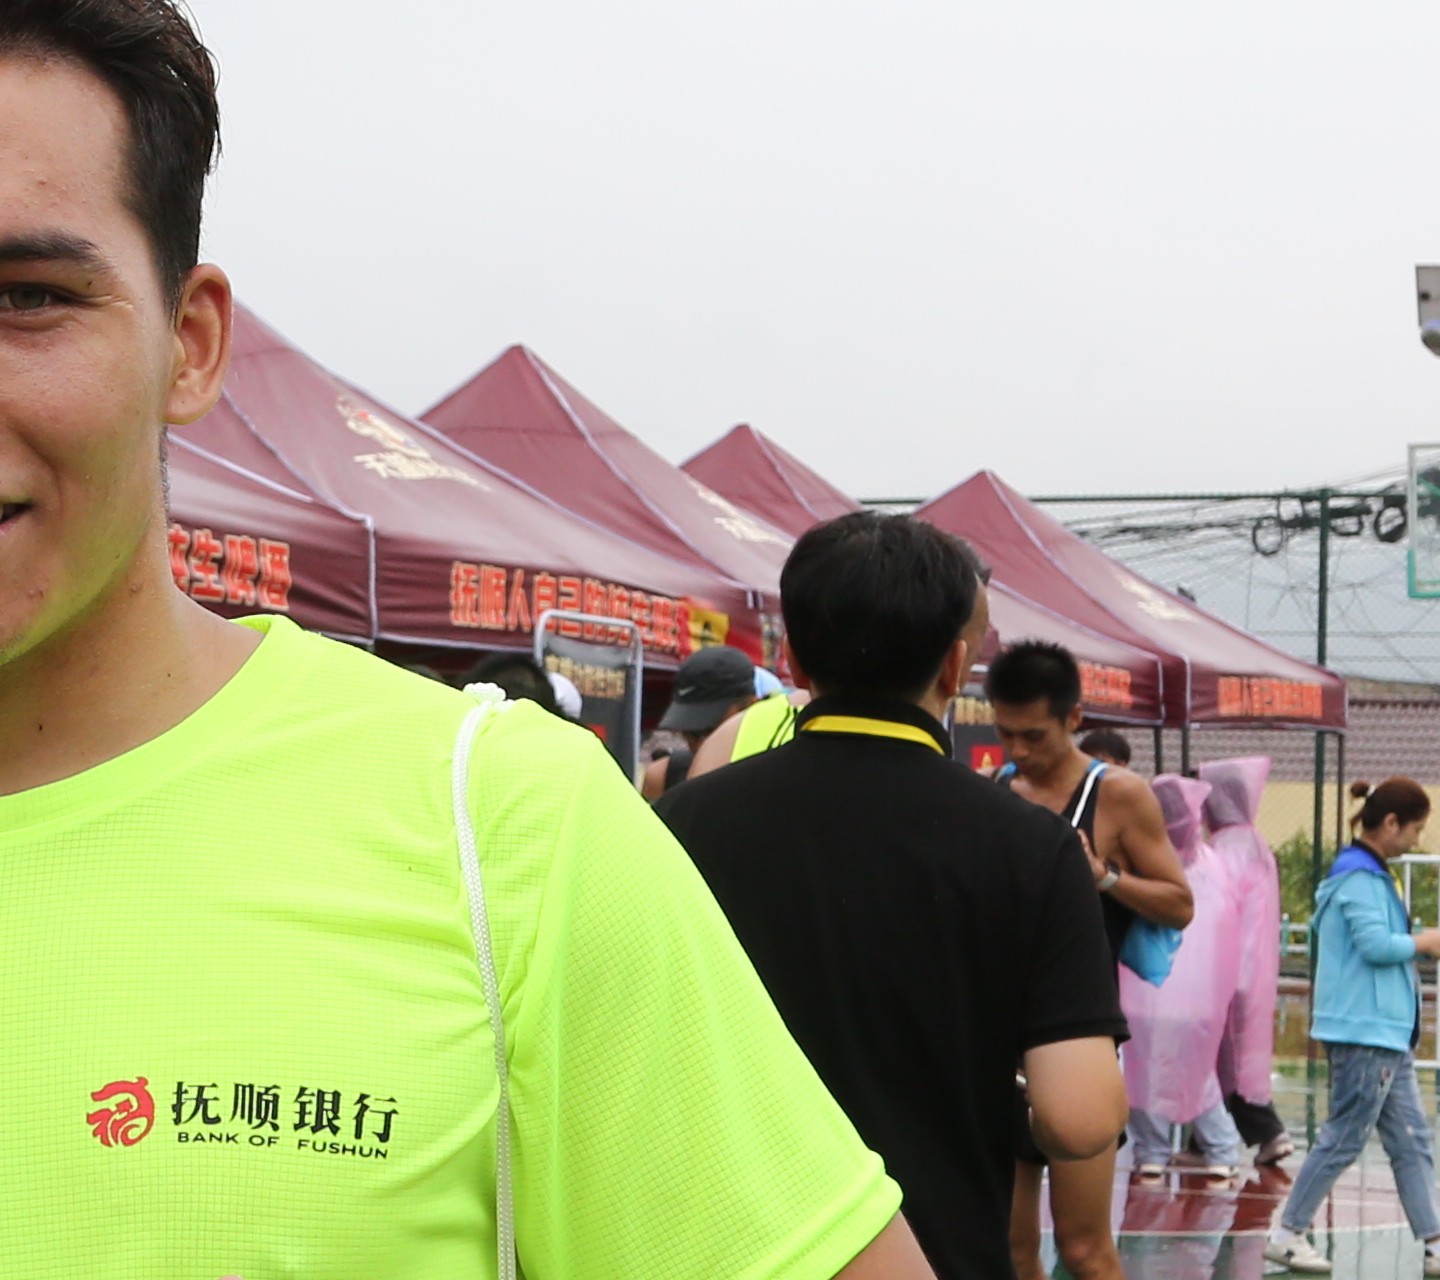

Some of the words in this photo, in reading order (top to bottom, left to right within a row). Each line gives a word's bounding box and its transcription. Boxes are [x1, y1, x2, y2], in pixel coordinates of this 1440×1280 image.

[171, 1081, 399, 1144] 抚顺银行
[177, 1131, 240, 1145] BANK
[248, 1134, 281, 1148] OF
[297, 1138, 389, 1160] FUSHUN
